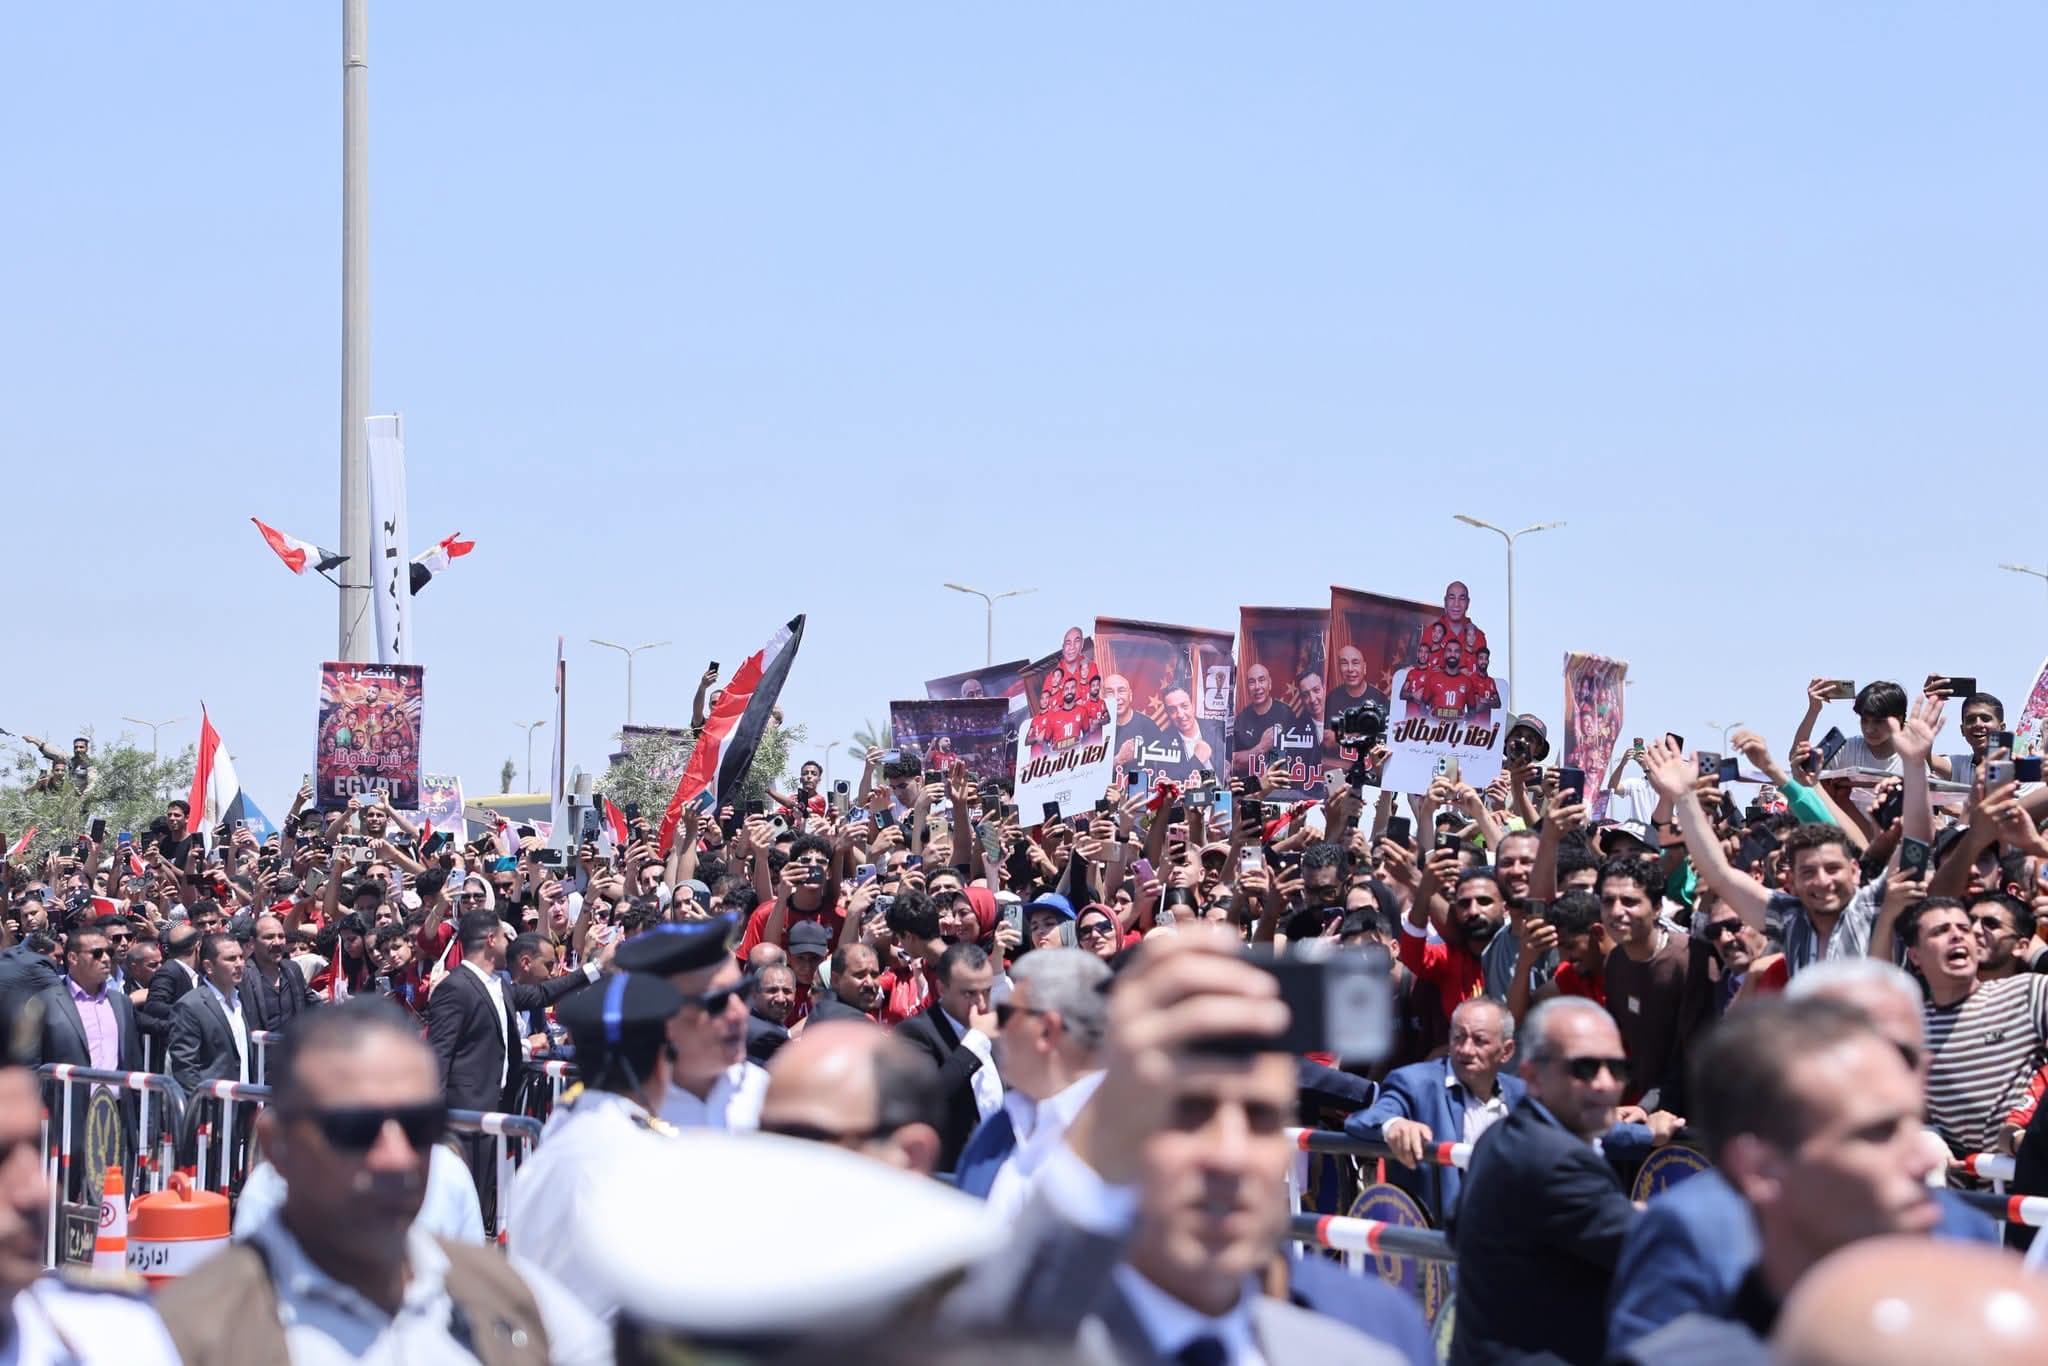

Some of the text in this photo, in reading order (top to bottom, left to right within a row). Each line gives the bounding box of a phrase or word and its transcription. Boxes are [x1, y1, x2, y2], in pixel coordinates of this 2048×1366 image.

[1444, 690, 1456, 706] 10
[1063, 722, 1073, 737] 10
[334, 775, 402, 799] EGYPT
